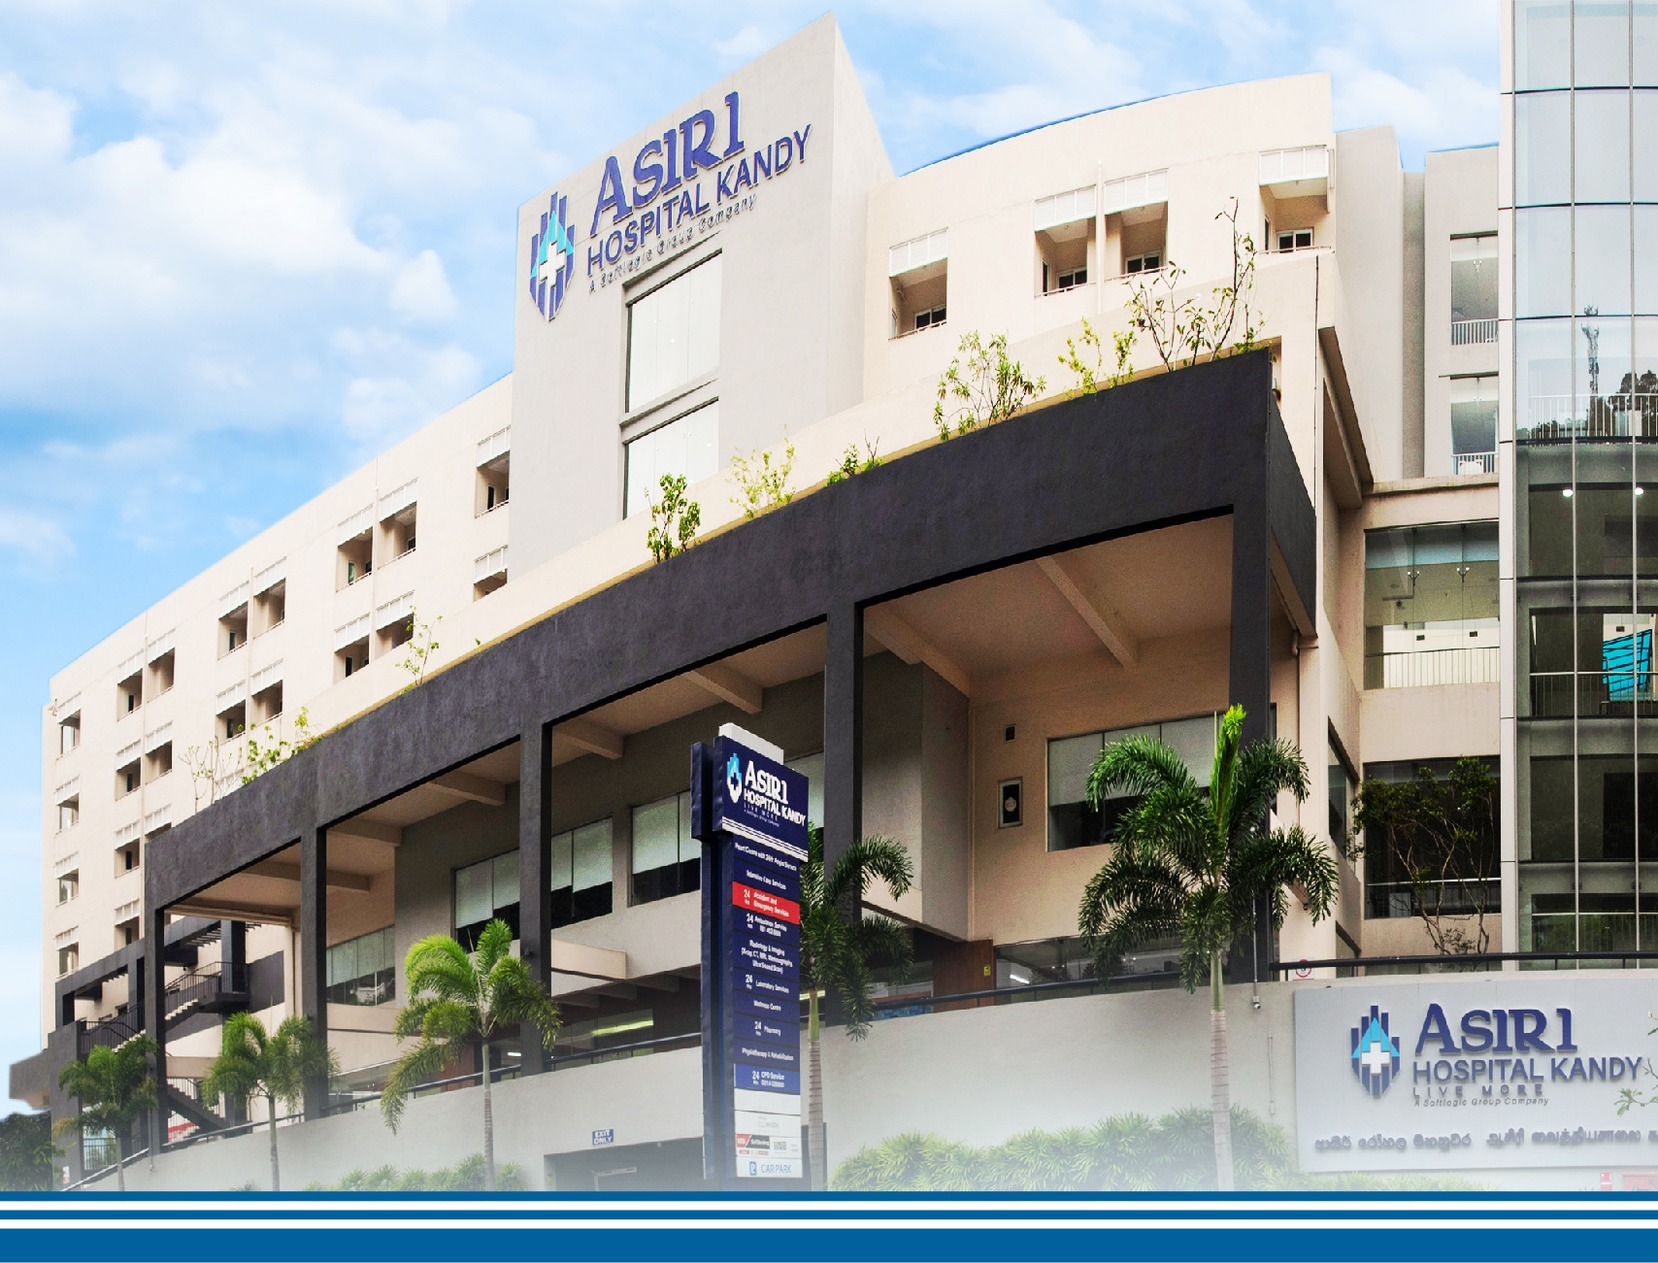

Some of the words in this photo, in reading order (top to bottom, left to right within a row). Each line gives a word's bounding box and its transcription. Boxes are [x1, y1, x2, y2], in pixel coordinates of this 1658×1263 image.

[590, 91, 744, 237] ASIRI
[587, 183, 710, 277] HOSPITAL
[717, 124, 812, 204] KANDY
[589, 280, 596, 293] A
[600, 249, 653, 288] Softlogic
[657, 227, 693, 255] Group
[699, 194, 757, 233] Company
[744, 788, 781, 816] HOSPITAL
[782, 805, 806, 827] KANDY
[743, 889, 750, 898] 24
[745, 974, 753, 983] 24
[754, 1021, 762, 1030] 24
[1415, 1003, 1578, 1056] ASIRI
[752, 1070, 760, 1080] 24
[1413, 1058, 1544, 1083] HOSPITAL
[1551, 1057, 1643, 1082] KANDY
[1413, 1085, 1463, 1098] LIVE
[1482, 1084, 1543, 1097] MORE
[1414, 1099, 1420, 1107] A
[1424, 1098, 1467, 1108] Softlogic
[1472, 1098, 1501, 1107] Group
[1505, 1097, 1549, 1107] Company
[595, 1130, 610, 1138] EXIT
[594, 1136, 612, 1145] ONLY
[761, 1164, 774, 1173] CAR
[775, 1164, 792, 1174] PARK
